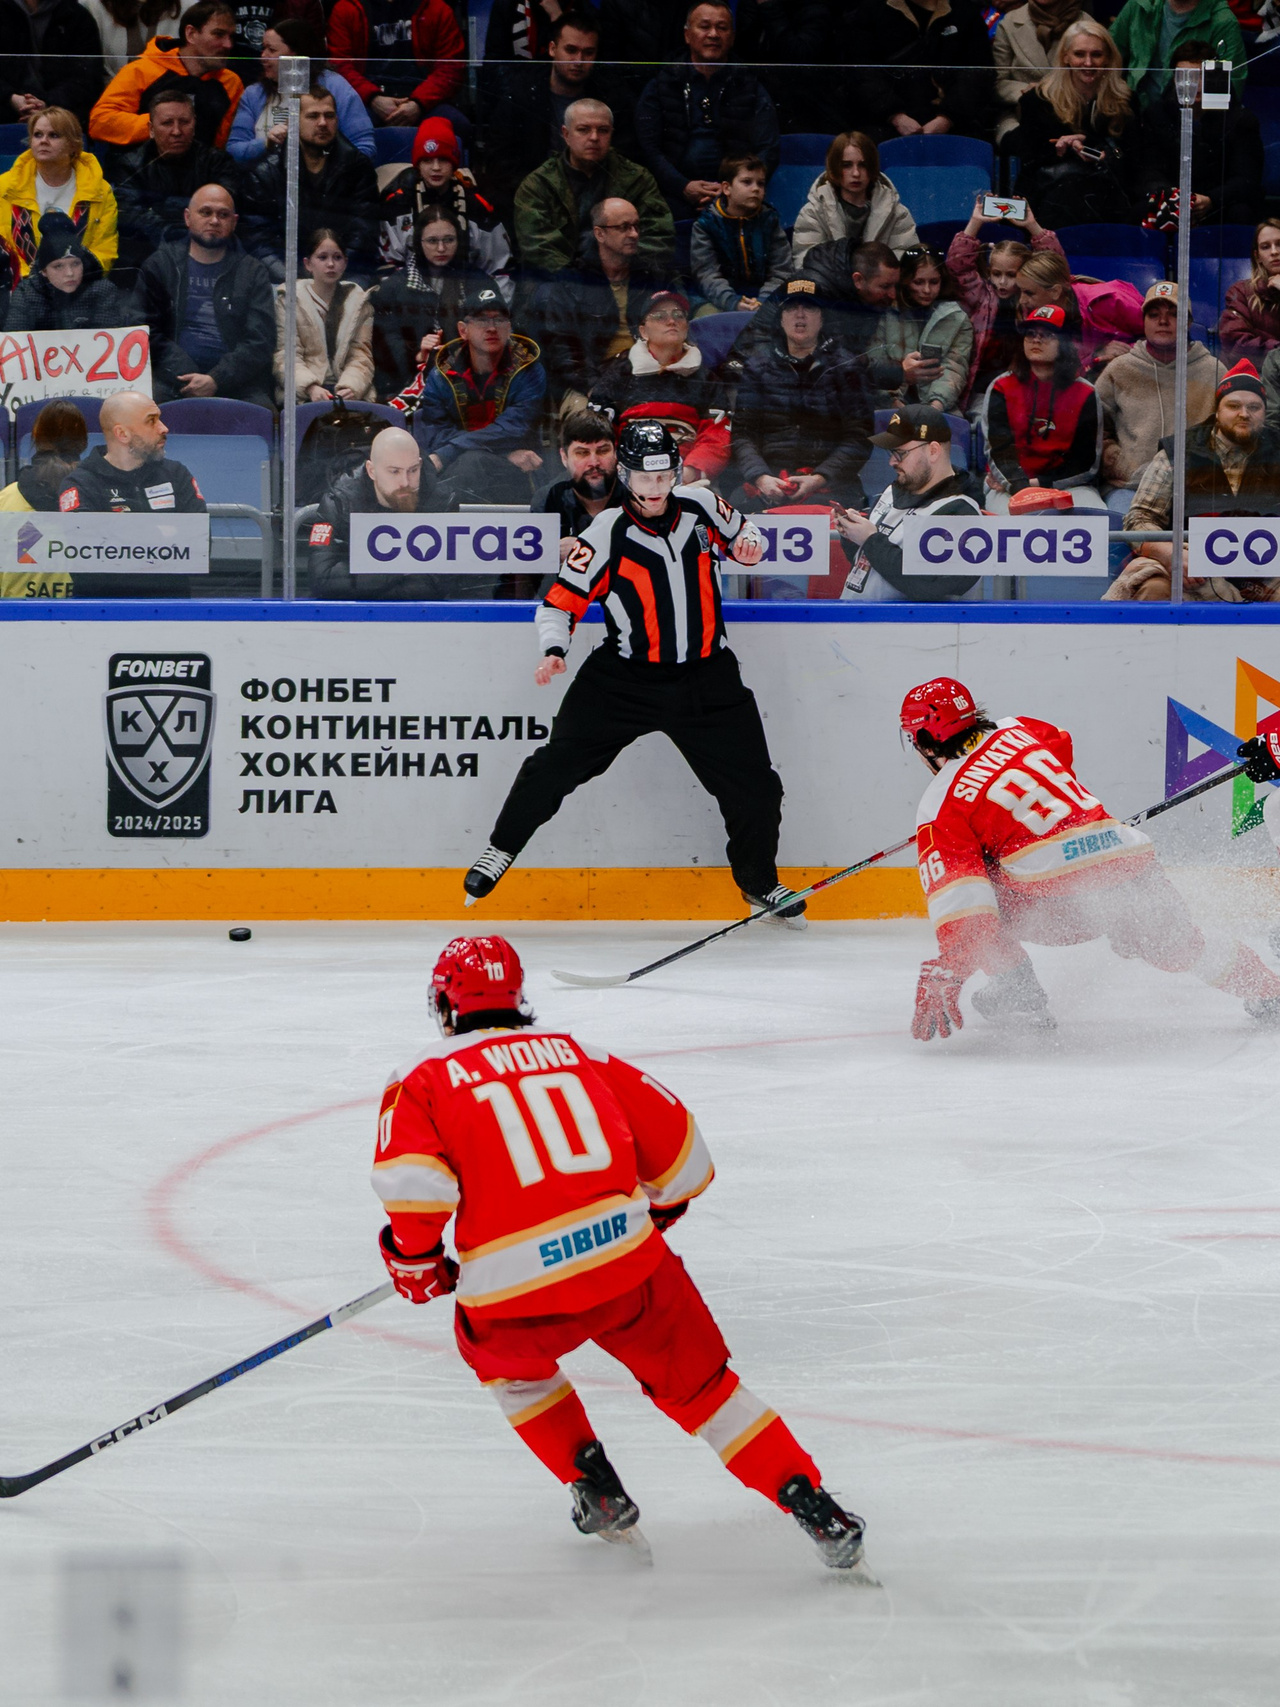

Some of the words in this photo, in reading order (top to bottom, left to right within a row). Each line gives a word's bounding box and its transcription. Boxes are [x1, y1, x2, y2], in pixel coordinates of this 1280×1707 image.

[644, 458, 669, 467] согаз
[48, 541, 190, 560] Ростелеком
[367, 525, 543, 562] согаз
[918, 527, 1093, 563] согаз
[114, 660, 204, 678] FONBET
[240, 677, 397, 703] ФОНБЕТ
[952, 695, 969, 710] 86
[121, 710, 143, 732] К
[173, 710, 197, 733] Л
[241, 715, 557, 741] КОНТИНЕНТАЛЬ
[239, 746, 479, 778] ХОККЕЙНАЯ
[238, 789, 338, 814] ЛИГА
[985, 748, 1104, 836] 86
[114, 815, 202, 830] 2024/2025
[917, 850, 946, 894] 86
[483, 961, 505, 981] 10
[445, 1058, 482, 1089] A.
[481, 1037, 580, 1075] WONG
[470, 1071, 613, 1189] 10
[538, 1212, 628, 1268] SIBUR
[90, 1403, 168, 1455] CCM
